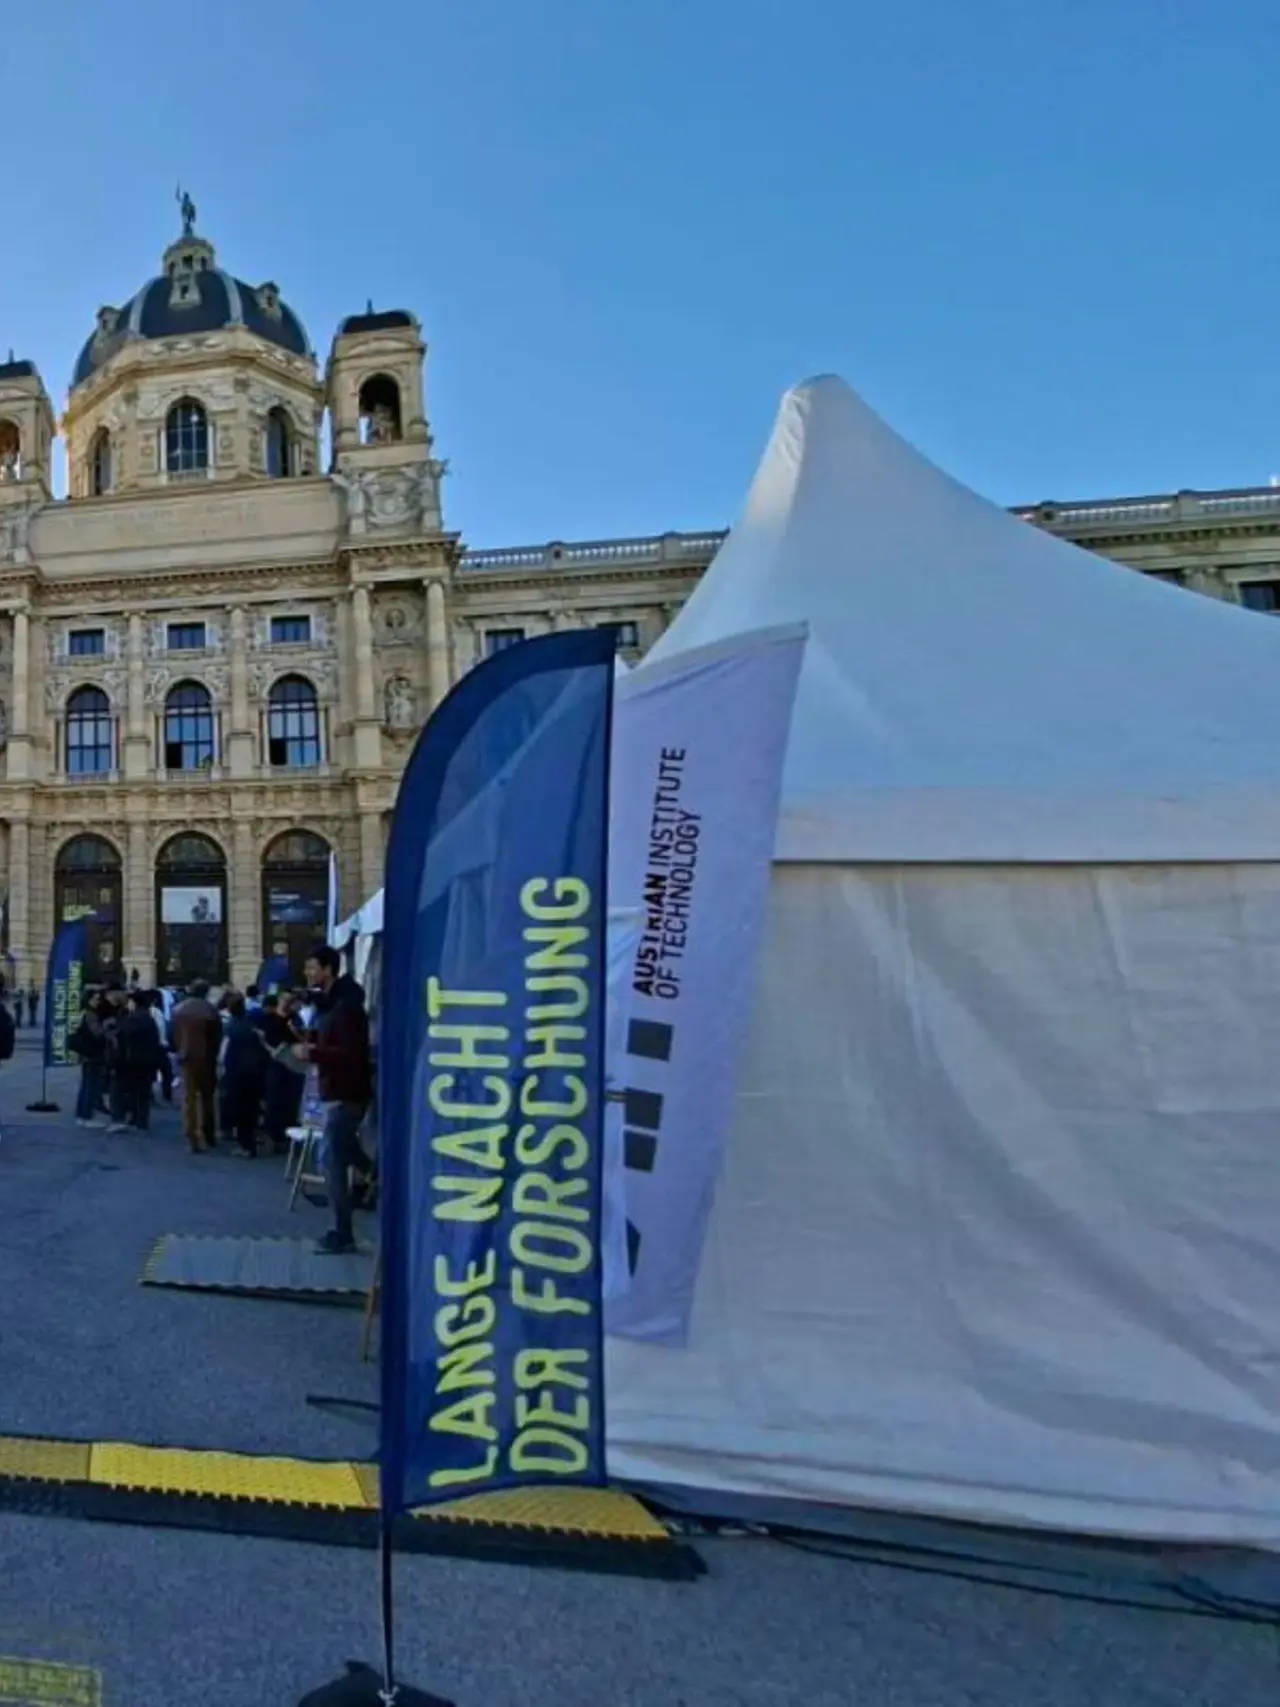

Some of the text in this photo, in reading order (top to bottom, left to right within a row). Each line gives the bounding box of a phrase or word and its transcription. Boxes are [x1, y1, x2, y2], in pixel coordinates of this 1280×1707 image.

[632, 746, 686, 997] AUSTRIAN INSTITUTE
[654, 810, 702, 1001] OF TECHNOLOGY
[427, 976, 512, 1488] LANGE NACHT
[510, 876, 593, 1475] DER FORSCHUNG
